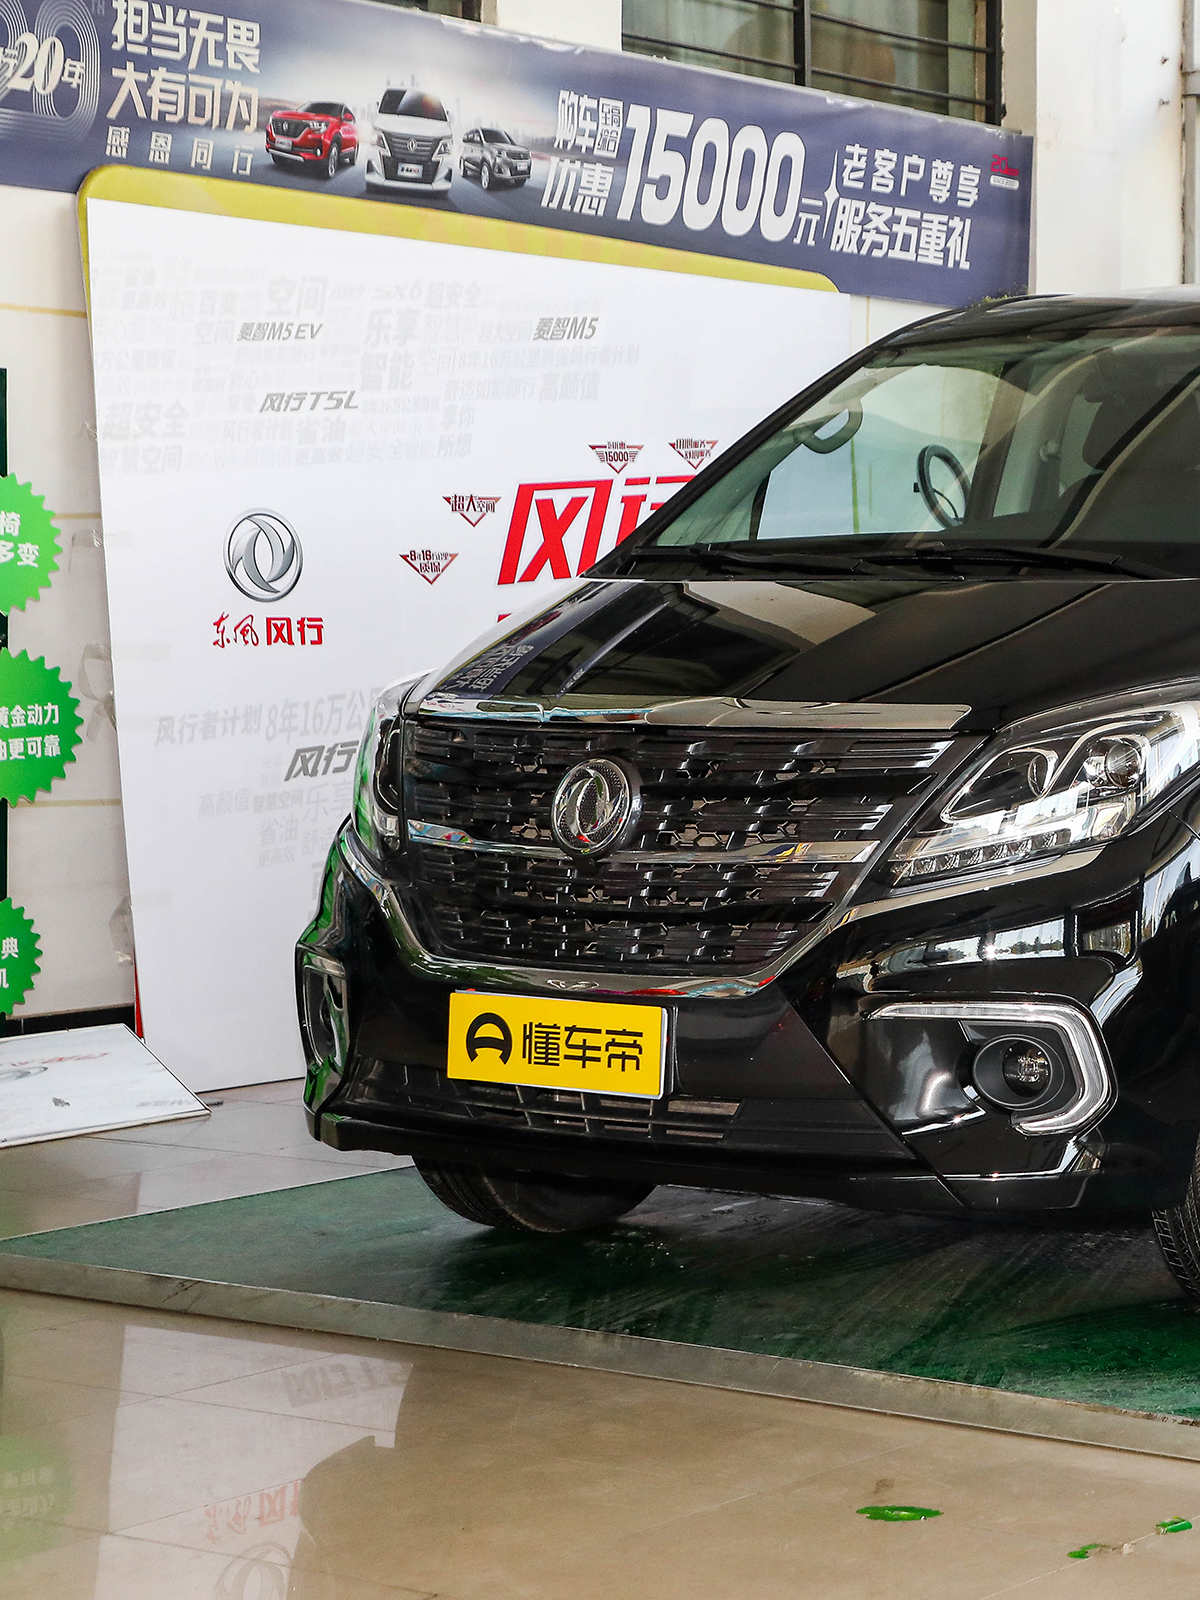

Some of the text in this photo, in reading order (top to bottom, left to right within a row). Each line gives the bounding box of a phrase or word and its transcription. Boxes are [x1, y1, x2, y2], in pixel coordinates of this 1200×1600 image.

[111, 0, 260, 74] 担当无畏
[106, 60, 260, 133] 大有可为
[105, 125, 255, 176] 感恩同行
[841, 142, 982, 208] 老客户尊享
[540, 155, 616, 217] 优惠
[830, 196, 973, 271] 服务五重礼
[265, 274, 330, 318] 空间
[101, 399, 191, 442] 超安全
[155, 702, 263, 747] 风行者计划
[522, 1021, 644, 1072] 懂车帝
